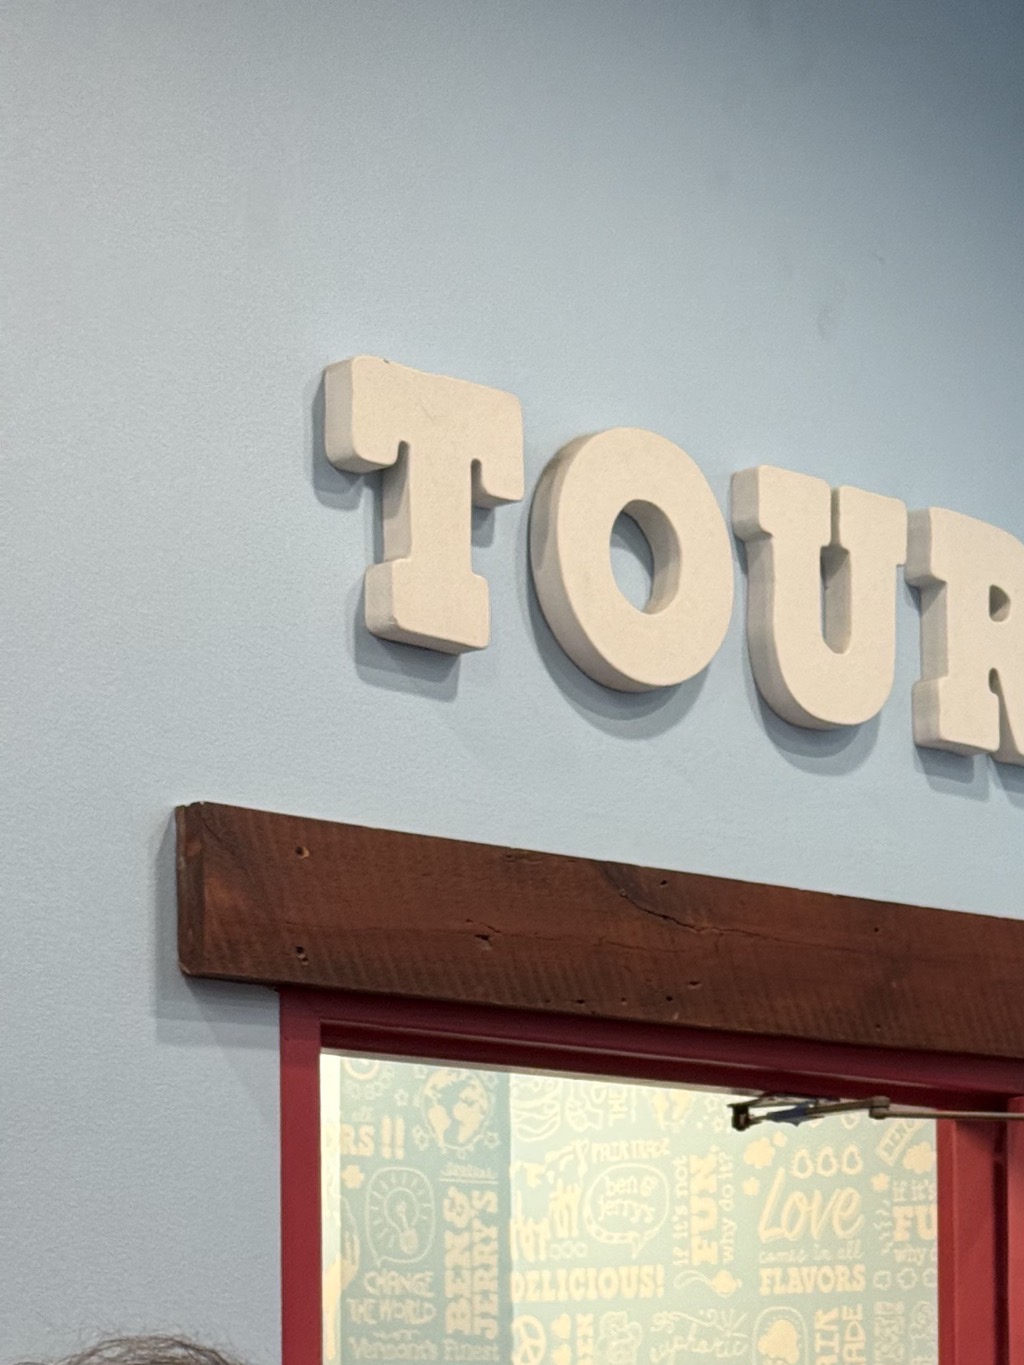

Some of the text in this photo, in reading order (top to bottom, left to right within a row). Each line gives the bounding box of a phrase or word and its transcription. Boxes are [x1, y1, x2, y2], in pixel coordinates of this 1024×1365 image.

[603, 1175, 638, 1196] ben
[672, 1155, 689, 1198] not
[598, 1195, 655, 1224] jerry's
[718, 1151, 737, 1264] why do it?
[757, 1166, 865, 1243] Love
[444, 1229, 471, 1336] BEN
[472, 1190, 499, 1340] JERRY'S
[511, 1264, 665, 1303] DELICIOUS!
[759, 1264, 866, 1296] FLAVORS
